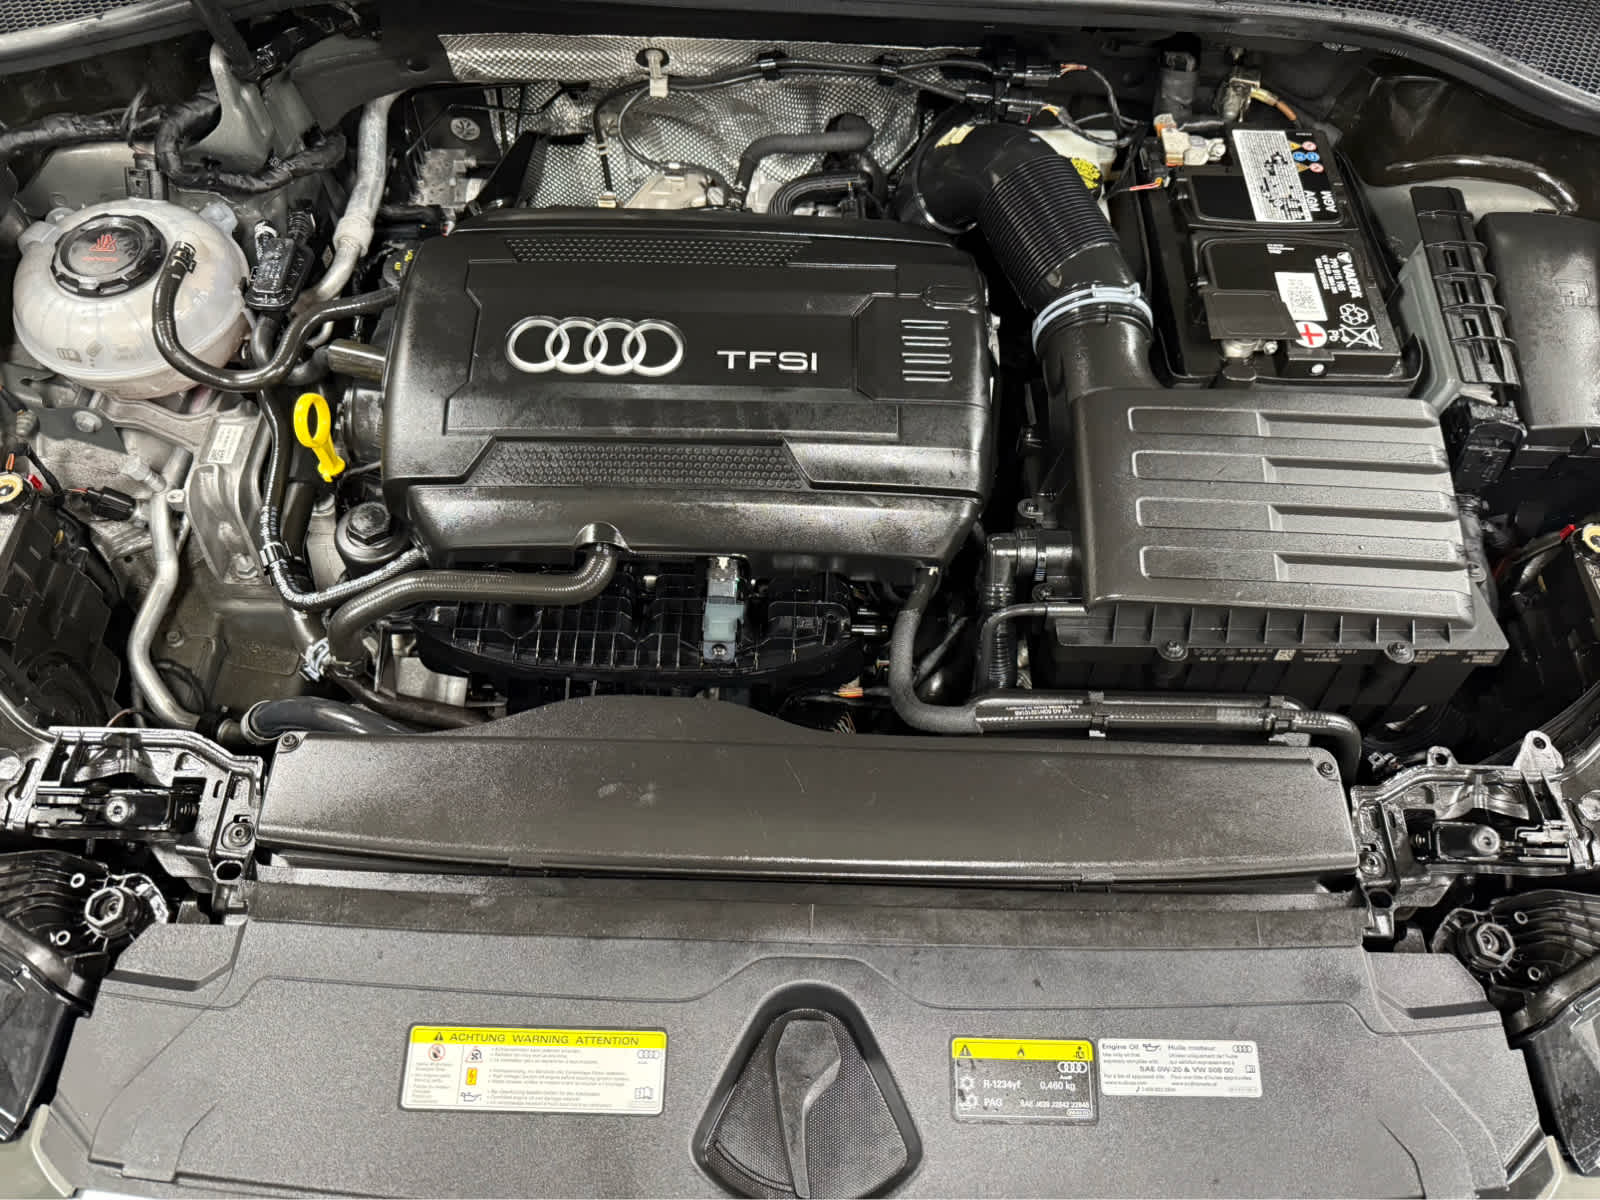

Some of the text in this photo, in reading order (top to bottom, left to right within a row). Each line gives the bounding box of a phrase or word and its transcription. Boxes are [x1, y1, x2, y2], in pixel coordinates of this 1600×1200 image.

[1304, 190, 1321, 212] AGM
[1342, 263, 1363, 299] VARTA
[1328, 330, 1340, 342] Pb
[717, 350, 818, 372] TFSI
[450, 1032, 640, 1046] ACHTUNG WARNING ATTENTION
[1102, 1043, 1127, 1051] Engine
[983, 1080, 1021, 1092] R-1234yf
[1065, 1081, 1077, 1092] kg
[983, 1098, 1003, 1108] PAG
